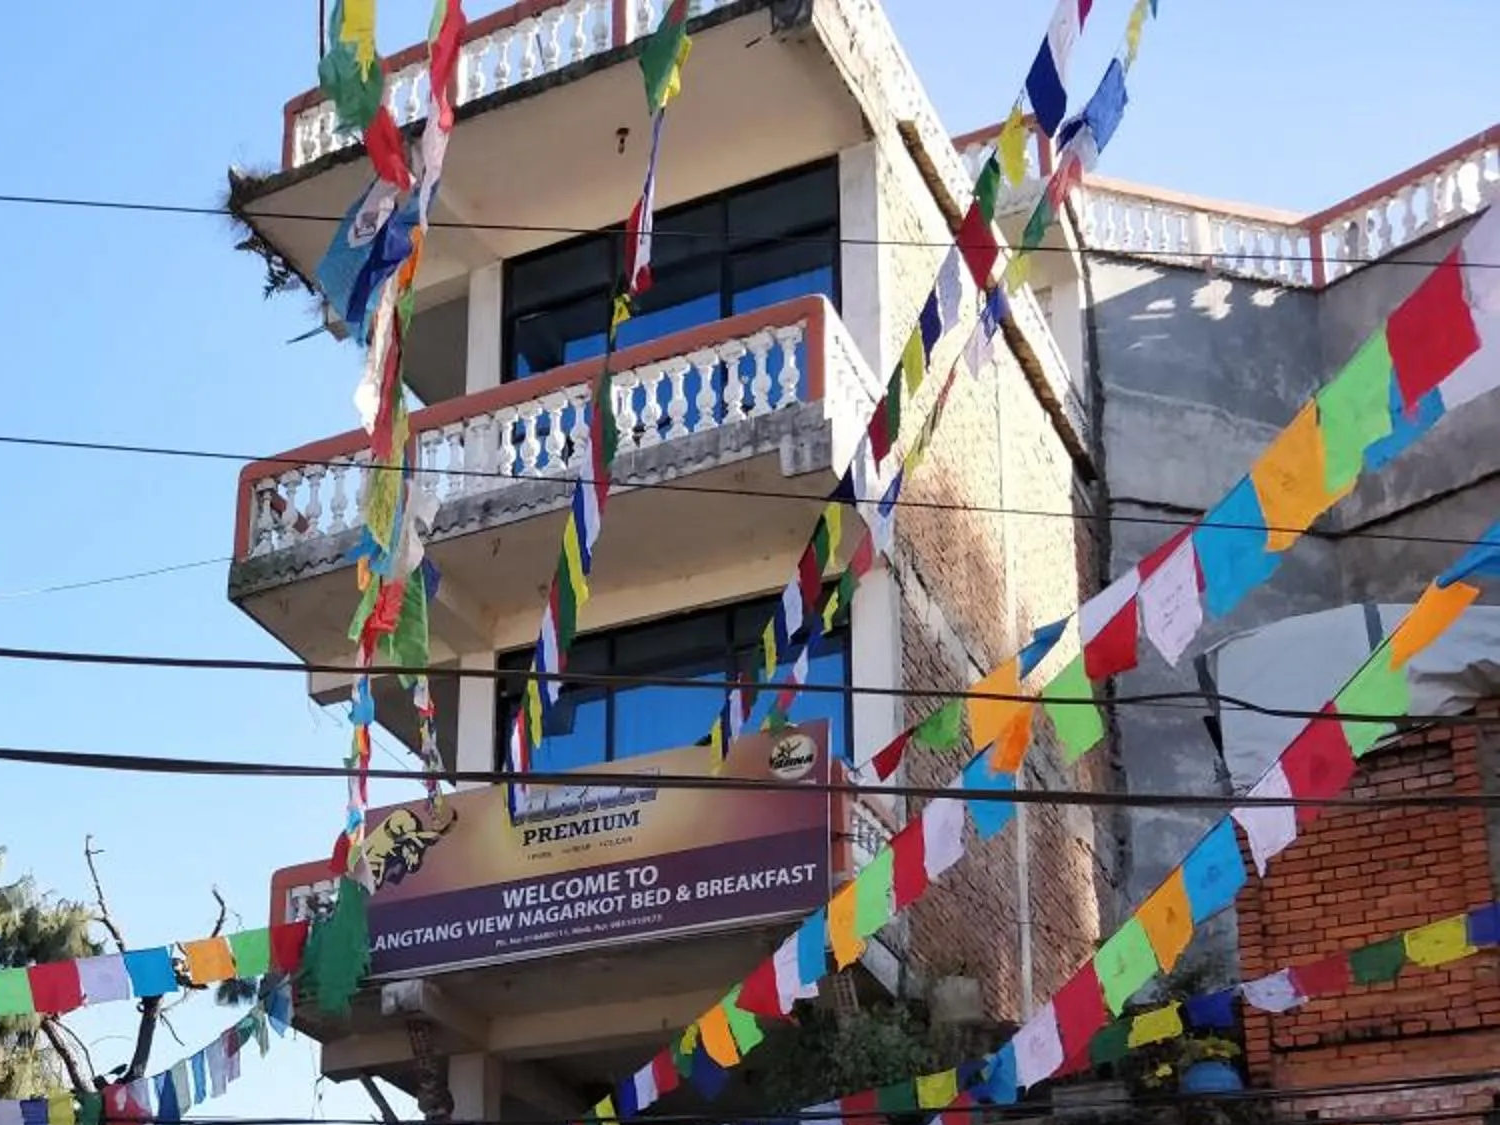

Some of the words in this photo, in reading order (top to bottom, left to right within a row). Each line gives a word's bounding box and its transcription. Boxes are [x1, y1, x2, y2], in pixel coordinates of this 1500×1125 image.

[522, 809, 641, 847] PREMIUM
[466, 913, 514, 938] VIEW
[517, 894, 627, 929] NAGARKOT
[630, 890, 671, 911] BED
[675, 885, 692, 903] &
[695, 863, 818, 901] BREAKFAST
[502, 870, 621, 910] WELCOME
[625, 864, 660, 889] TO
